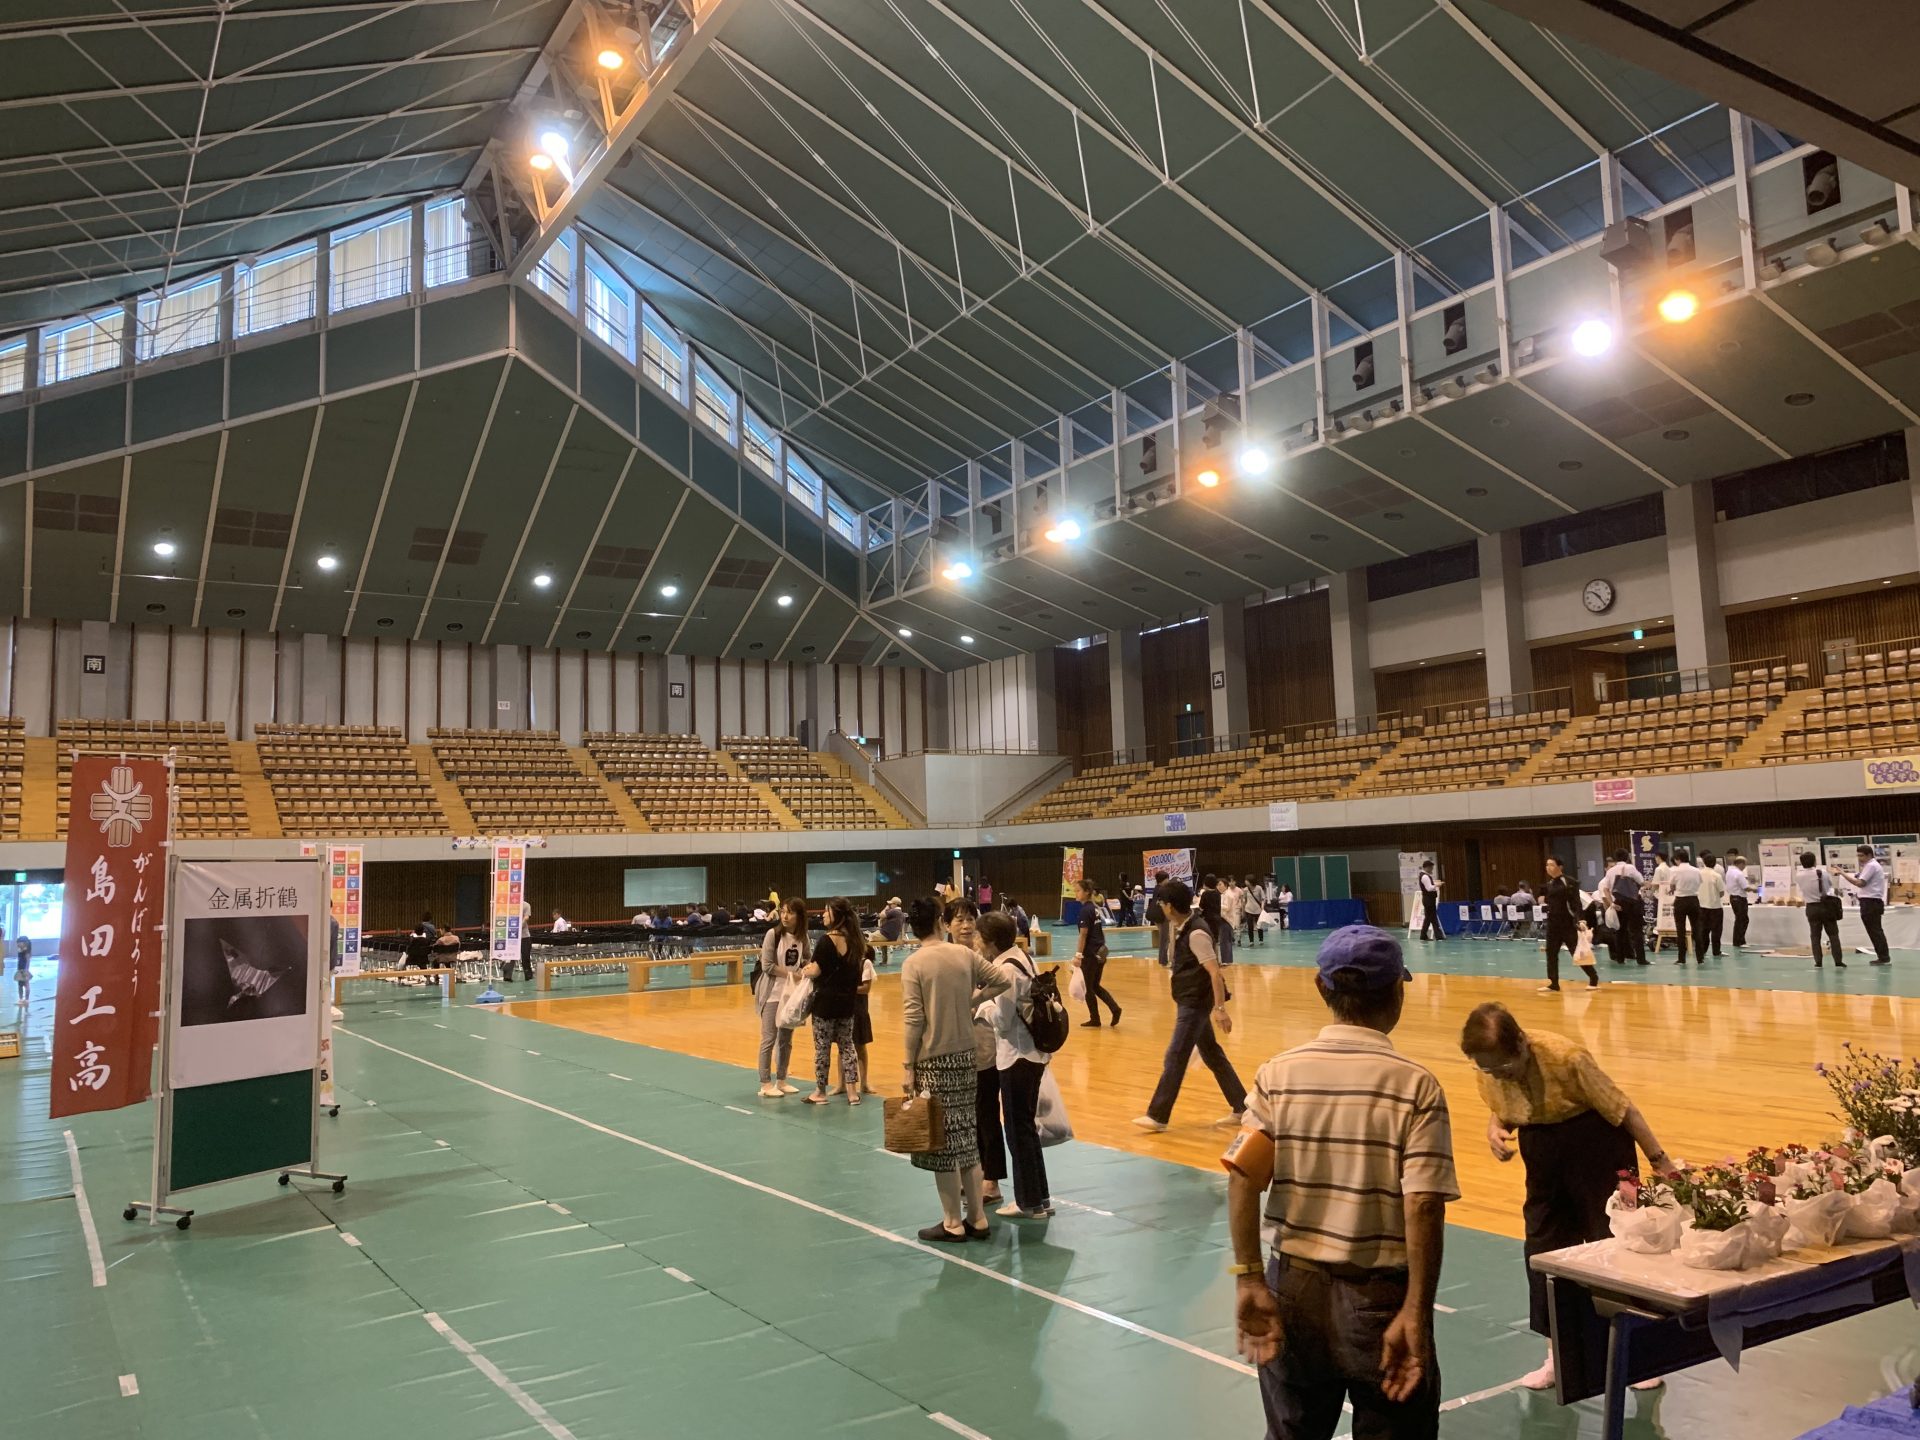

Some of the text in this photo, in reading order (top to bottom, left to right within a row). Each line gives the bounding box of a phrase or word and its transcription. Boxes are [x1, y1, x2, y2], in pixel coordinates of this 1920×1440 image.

[86, 657, 103, 671] 南
[671, 684, 682, 696] 南
[207, 886, 298, 912] 金属折鶴
[130, 850, 154, 997] がんばろう
[69, 854, 117, 1093] 島田工高
